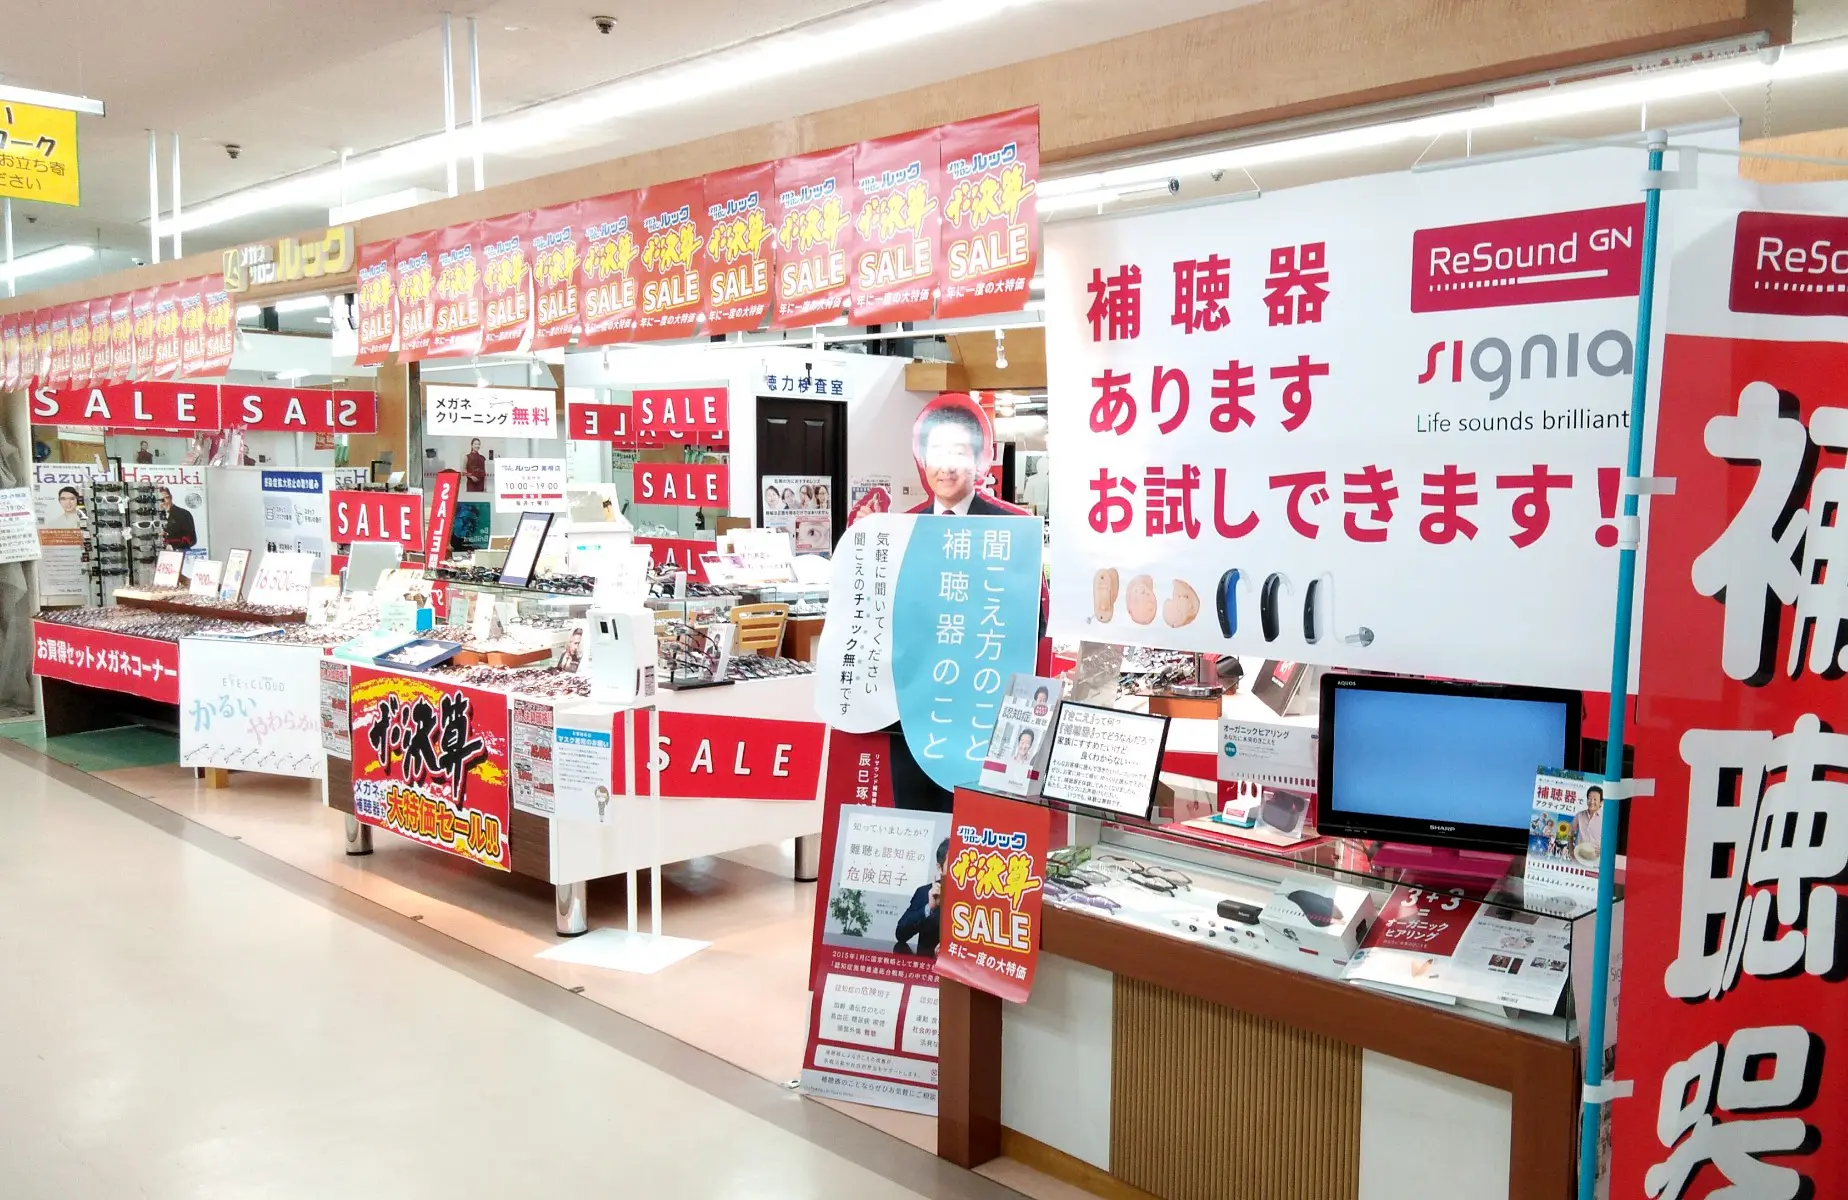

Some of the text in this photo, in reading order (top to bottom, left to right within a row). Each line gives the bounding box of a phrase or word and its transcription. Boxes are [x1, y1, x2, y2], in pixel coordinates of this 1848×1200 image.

[882, 162, 920, 187] ルック
[972, 143, 1016, 171] ルック
[726, 192, 758, 214] ルック
[800, 177, 835, 202] ルック
[660, 206, 689, 228] ルック
[277, 227, 349, 280] ルック
[859, 237, 932, 290] SALE
[949, 224, 1028, 281] SALE
[1429, 227, 1632, 276] ReSound GN
[643, 270, 700, 313] SALE
[711, 260, 767, 307] SALE
[782, 250, 846, 299] SALE
[945, 278, 1024, 298] 年に一度の大特価
[1087, 241, 1329, 342] 補聴器
[437, 299, 478, 333] SALE
[486, 294, 527, 330] SALE
[538, 286, 577, 326] SALE
[585, 278, 635, 319] SALE
[709, 305, 764, 321] 年に一度の大特価
[362, 311, 392, 342] SALE
[402, 303, 433, 340] SALE
[207, 334, 232, 359] SALE
[1418, 329, 1633, 401] signia
[33, 387, 196, 423] SALE
[436, 398, 472, 410] メガネ
[642, 396, 717, 425] SALE
[1089, 355, 1329, 436] あります
[436, 411, 508, 425] クリーニング
[512, 407, 549, 426] 無料
[1417, 409, 1629, 433] Life sounds brilliant
[121, 467, 203, 485] Hazuki
[642, 473, 718, 500] SALE
[337, 502, 411, 541] SALE
[1088, 464, 1621, 548] お試しできます!
[840, 532, 866, 716] 聞こえのチェック無料です
[865, 532, 890, 694] 気軽に聞いてください
[36, 637, 177, 682] お買得セットメガネコーナー
[923, 528, 972, 760] 補聴器のこと
[965, 530, 1011, 762] 聞こえ方のこと
[189, 694, 257, 732] かるい
[1057, 736, 1128, 755] 家族にすすめたいけど
[1223, 725, 1290, 740] オーガニックヒアリング
[646, 735, 792, 777] SALE
[856, 753, 871, 806] 辰巳琢
[1537, 785, 1584, 805] 補聴器で
[982, 830, 1026, 849] ルック
[1429, 824, 1455, 832] SHARP
[850, 843, 926, 862] 難聴も認知症の
[847, 866, 908, 887] 危険因子
[952, 902, 1031, 953] SALE
[1384, 928, 1440, 942] ヒアリング
[1385, 919, 1450, 932] オーガニック
[948, 942, 1027, 980] 年に一度の大特価
